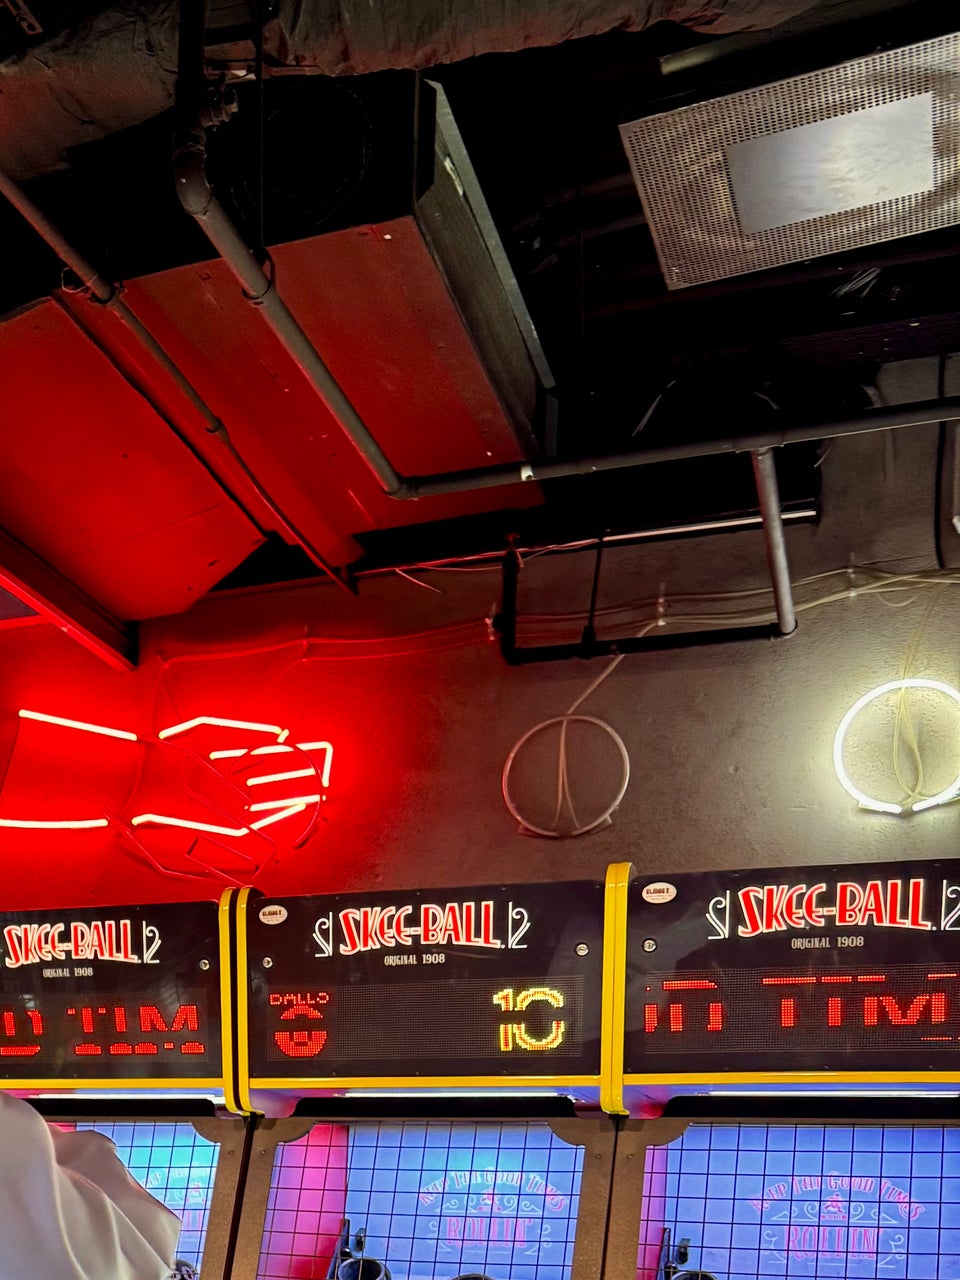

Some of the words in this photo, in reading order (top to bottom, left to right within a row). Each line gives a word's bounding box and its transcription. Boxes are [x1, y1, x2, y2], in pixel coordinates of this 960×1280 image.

[737, 878, 932, 938] SKEE-BALL
[339, 901, 501, 956] SKEE-BALL
[4, 919, 139, 968] SKEE-BALL
[791, 937, 831, 950] ORIGINAL
[836, 936, 864, 948] 1908
[384, 954, 418, 966] ORIGINAL
[422, 953, 446, 964] 1908
[74, 967, 94, 977] 1908
[827, 1171, 876, 1193] GOOD
